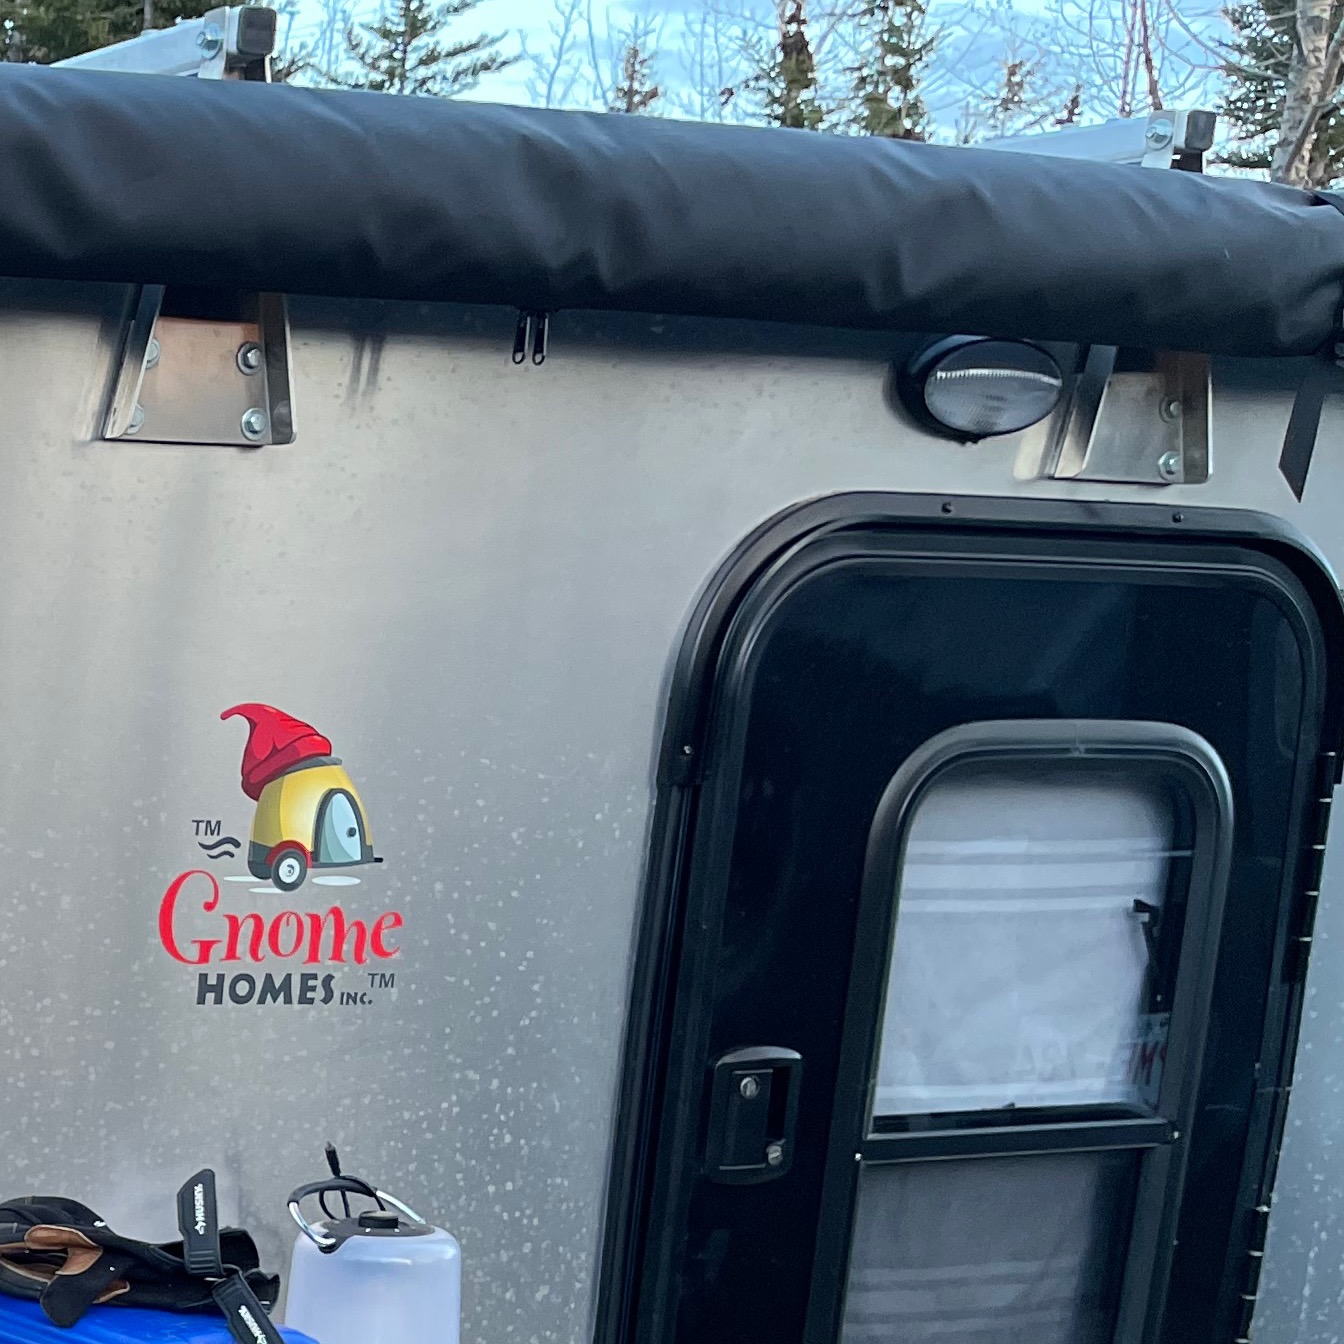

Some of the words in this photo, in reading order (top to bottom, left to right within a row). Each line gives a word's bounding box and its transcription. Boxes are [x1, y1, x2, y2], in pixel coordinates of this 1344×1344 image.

[158, 869, 404, 965] Gnome
[196, 972, 336, 1006] HOMES
[339, 991, 374, 1006] INC.
[368, 973, 395, 989] TM
[194, 1183, 205, 1223] HUSKY
